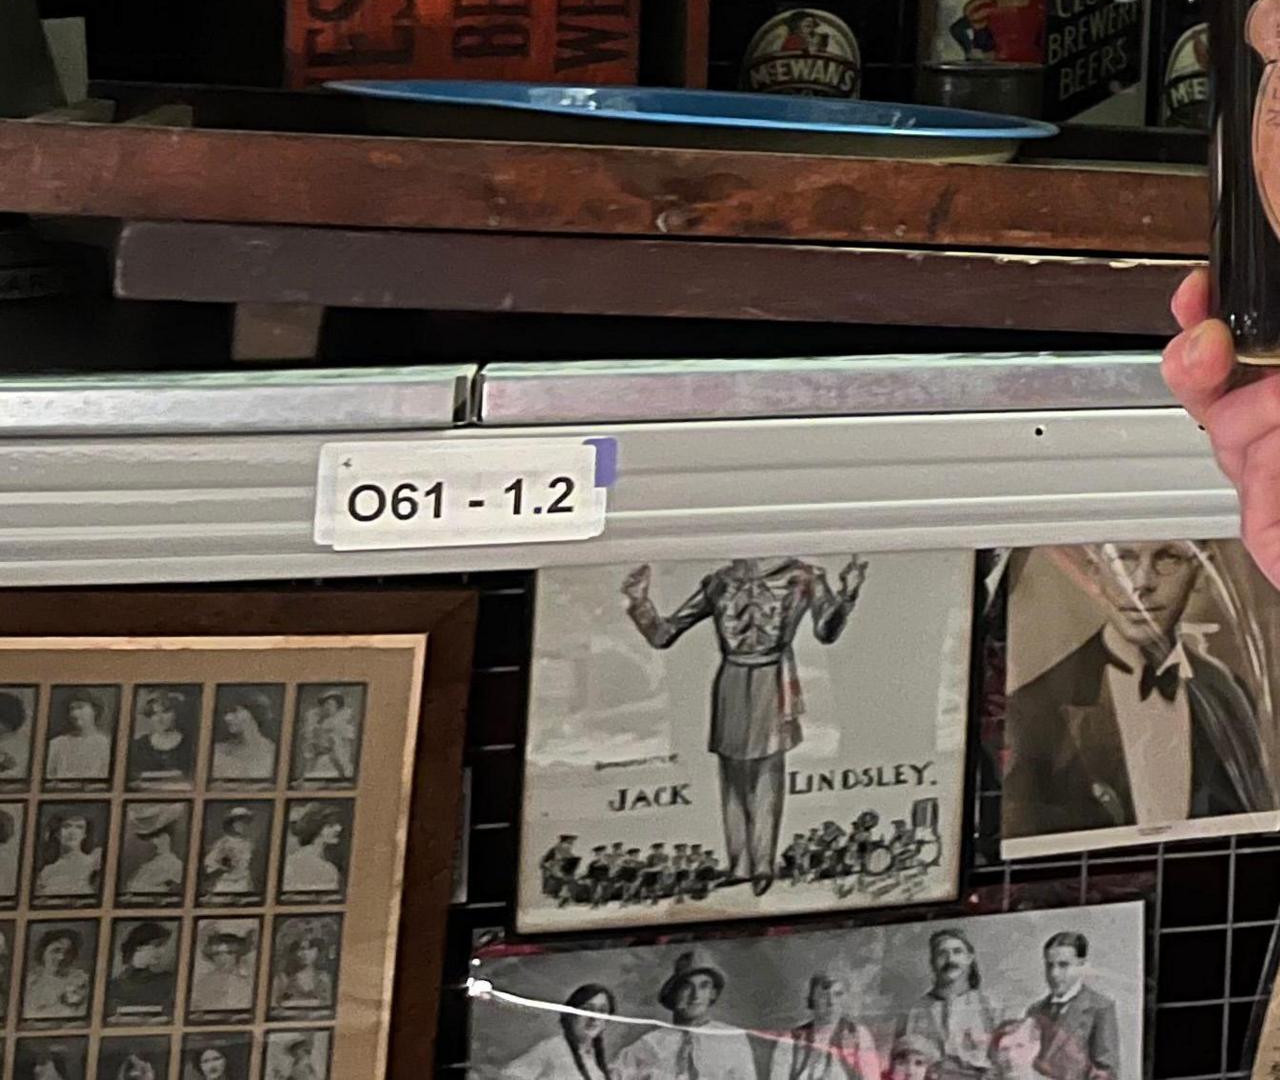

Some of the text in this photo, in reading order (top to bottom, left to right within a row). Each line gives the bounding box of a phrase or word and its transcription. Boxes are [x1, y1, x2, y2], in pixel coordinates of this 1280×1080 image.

[1059, 36, 1128, 101] BEERS
[504, 477, 575, 515] 1.2
[609, 783, 693, 811] JACK
